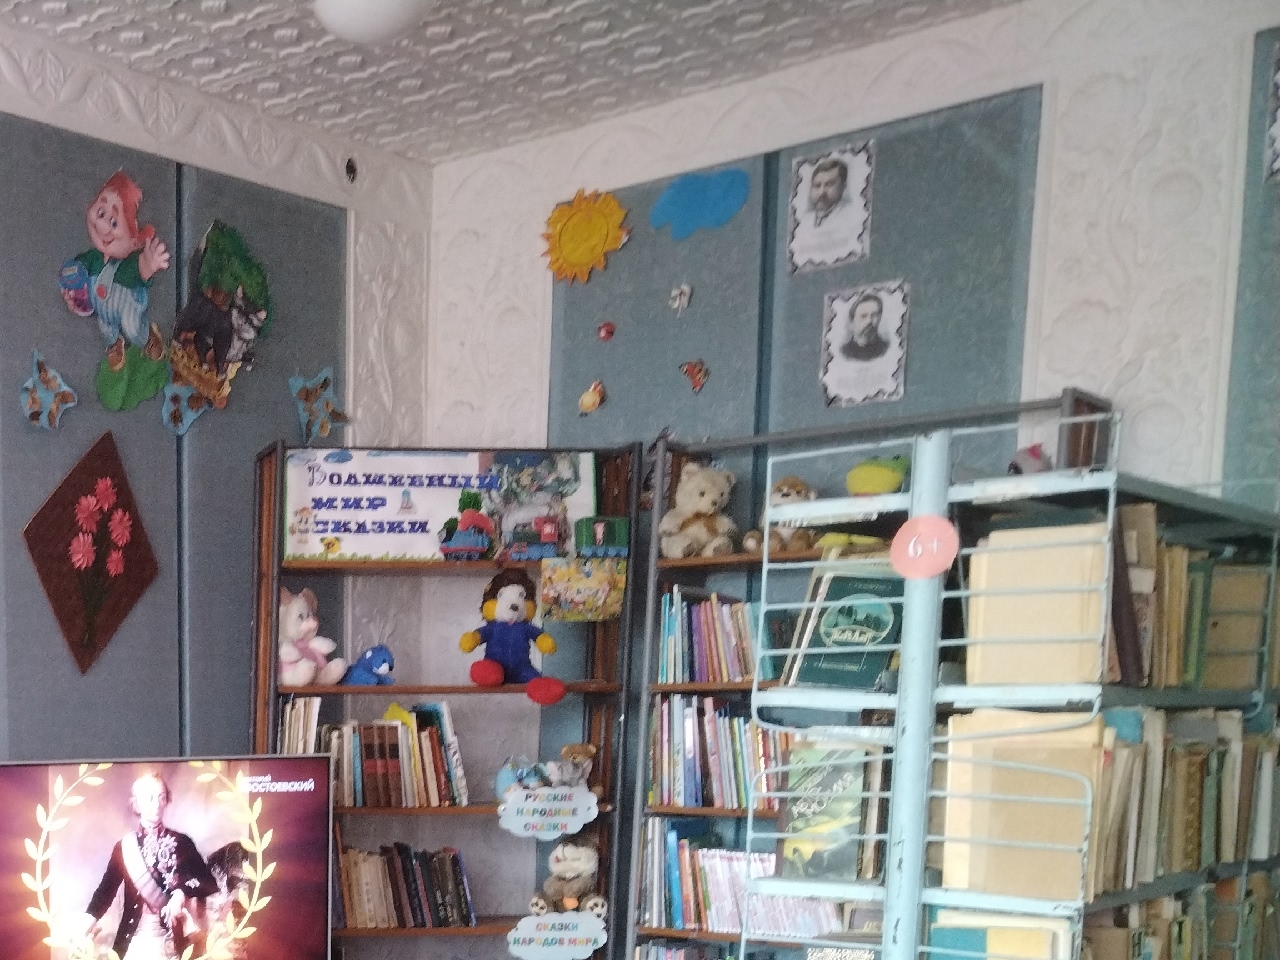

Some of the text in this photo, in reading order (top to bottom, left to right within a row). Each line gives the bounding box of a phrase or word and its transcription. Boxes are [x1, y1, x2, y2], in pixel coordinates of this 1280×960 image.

[241, 778, 315, 793] ОСТОЕВСКИЙ
[524, 792, 575, 803] РУССКИЕ
[516, 806, 579, 818] НАРОДНЫЕ
[523, 821, 569, 832] СКАЗКИ
[535, 921, 579, 932] СКАЗКИ
[512, 936, 600, 948] НАРОДОВ МИРА
